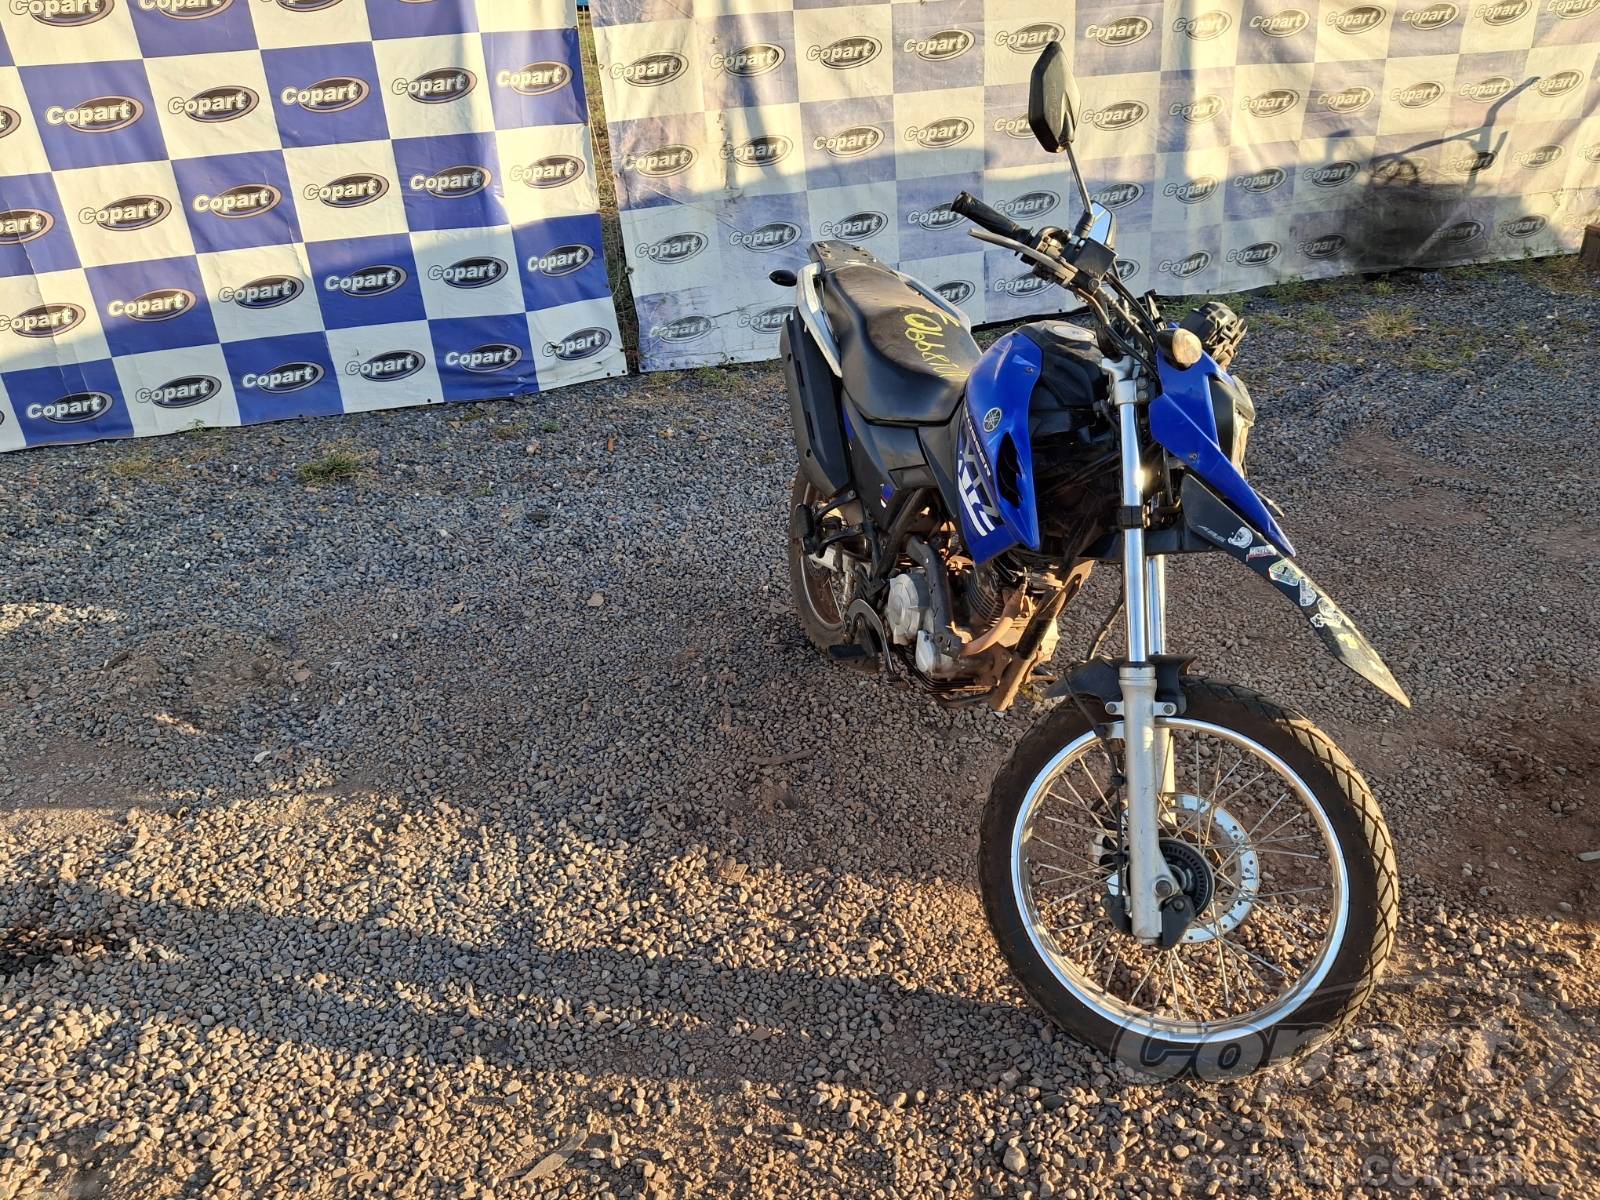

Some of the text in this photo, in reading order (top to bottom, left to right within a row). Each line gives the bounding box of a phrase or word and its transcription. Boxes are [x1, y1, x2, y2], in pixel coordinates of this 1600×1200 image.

[9, 0, 101, 19] Copart
[1325, 9, 1376, 27] Copart
[1402, 7, 1453, 24] Copart
[1474, 1, 1525, 20] Copart
[1085, 20, 1145, 40] Copart
[1172, 14, 1224, 33] Copart
[1250, 12, 1302, 30] Copart
[903, 33, 966, 54] Copart
[994, 27, 1056, 48] Copart
[710, 47, 779, 70] Copart
[806, 39, 873, 62] Copart
[497, 66, 562, 88] Copart
[609, 57, 678, 81] Copart
[281, 81, 359, 107] Copart
[392, 71, 466, 96] Copart
[1391, 84, 1437, 101] Copart
[1459, 79, 1508, 97] Copart
[168, 89, 247, 118] Copart
[1169, 98, 1219, 117] Copart
[1240, 92, 1292, 112] Copart
[1317, 89, 1368, 107] Copart
[46, 100, 132, 126] Copart
[1081, 104, 1139, 124] Copart
[904, 120, 966, 142] Copart
[993, 118, 1030, 133] Cop
[719, 140, 786, 161] Copart
[813, 130, 876, 151] Copart
[623, 150, 690, 171] Copart
[1511, 149, 1560, 165] Copart
[409, 168, 482, 191] Copart
[509, 159, 576, 182] Copart
[1234, 170, 1280, 188] Copart
[1303, 164, 1351, 182] Copart
[303, 177, 377, 201] Copart
[1088, 187, 1135, 205] opart
[1163, 179, 1213, 197] Copart
[193, 188, 275, 212] Copart
[993, 195, 1051, 216] Copart
[0, 213, 42, 233] art
[79, 200, 161, 226] Copart
[820, 214, 880, 237] Copart
[635, 234, 701, 259] Copart
[729, 225, 795, 248] Copart
[1296, 238, 1343, 253] Copart
[526, 246, 585, 273] Copart
[1226, 243, 1276, 262] Copart
[428, 258, 498, 281] Copart
[1159, 253, 1206, 274] Copart
[324, 268, 398, 291] Copart
[218, 278, 294, 303] Copart
[107, 291, 185, 318] Copart
[542, 332, 602, 357] Copart
[345, 353, 415, 376] Copart
[445, 345, 513, 367] Copart
[242, 365, 319, 389] Copart
[135, 378, 210, 403] Copart
[26, 392, 101, 419] Copart
